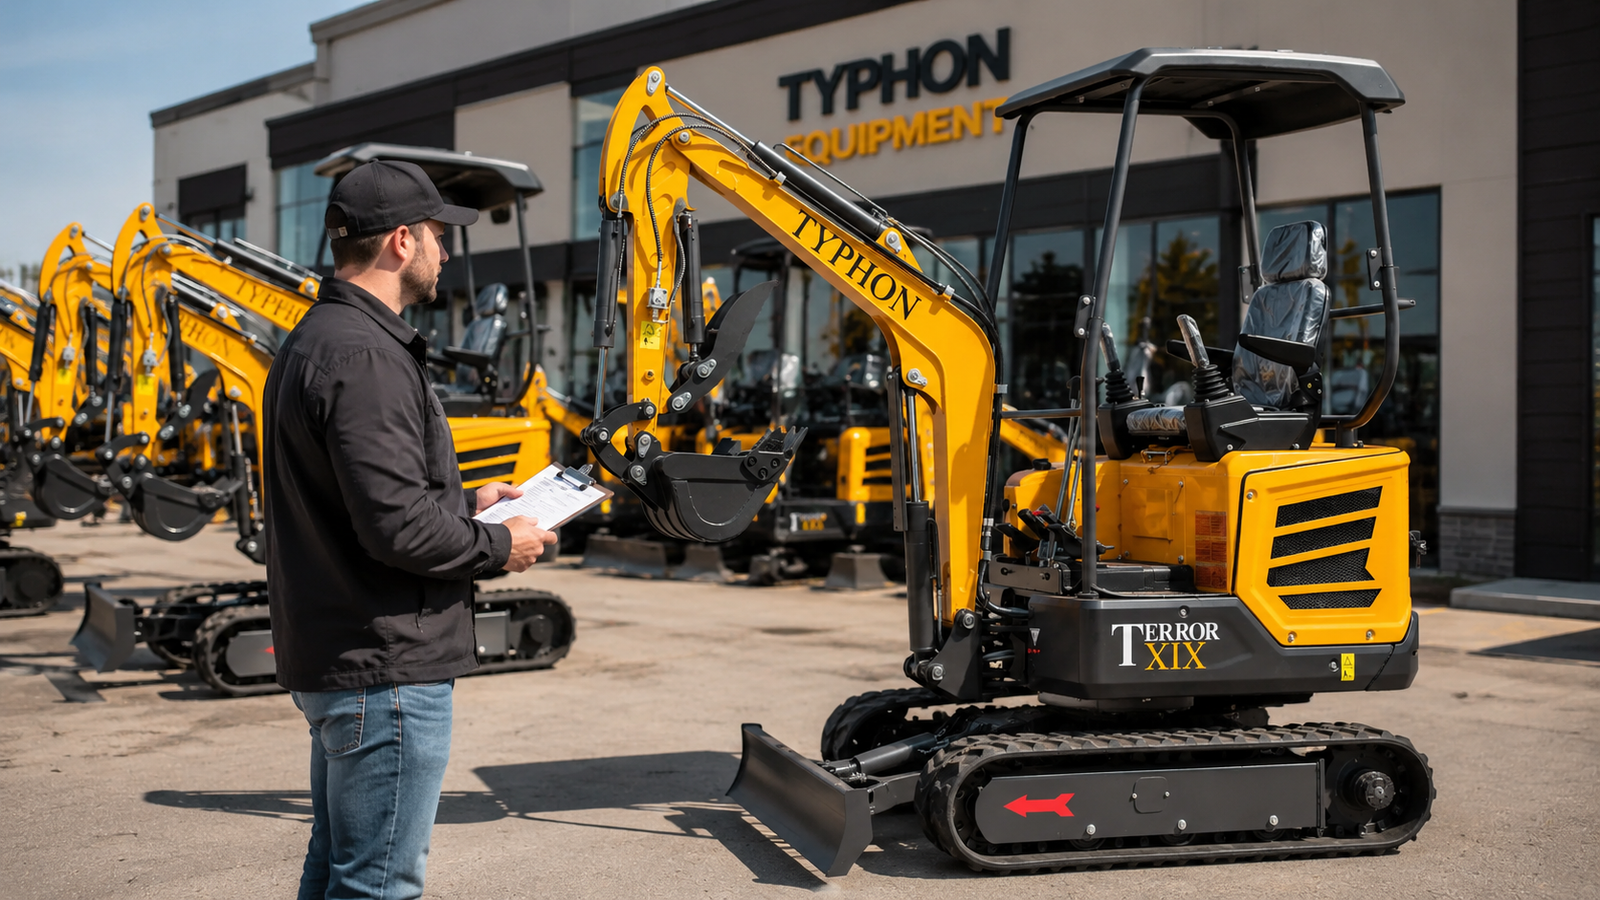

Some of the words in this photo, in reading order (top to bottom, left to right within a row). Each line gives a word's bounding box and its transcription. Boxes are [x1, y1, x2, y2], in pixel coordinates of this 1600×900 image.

[779, 27, 1011, 121] TYPHON
[785, 96, 1008, 166] EQUIPMENT
[792, 209, 922, 320] TYPHON
[1144, 641, 1206, 671] XIX
